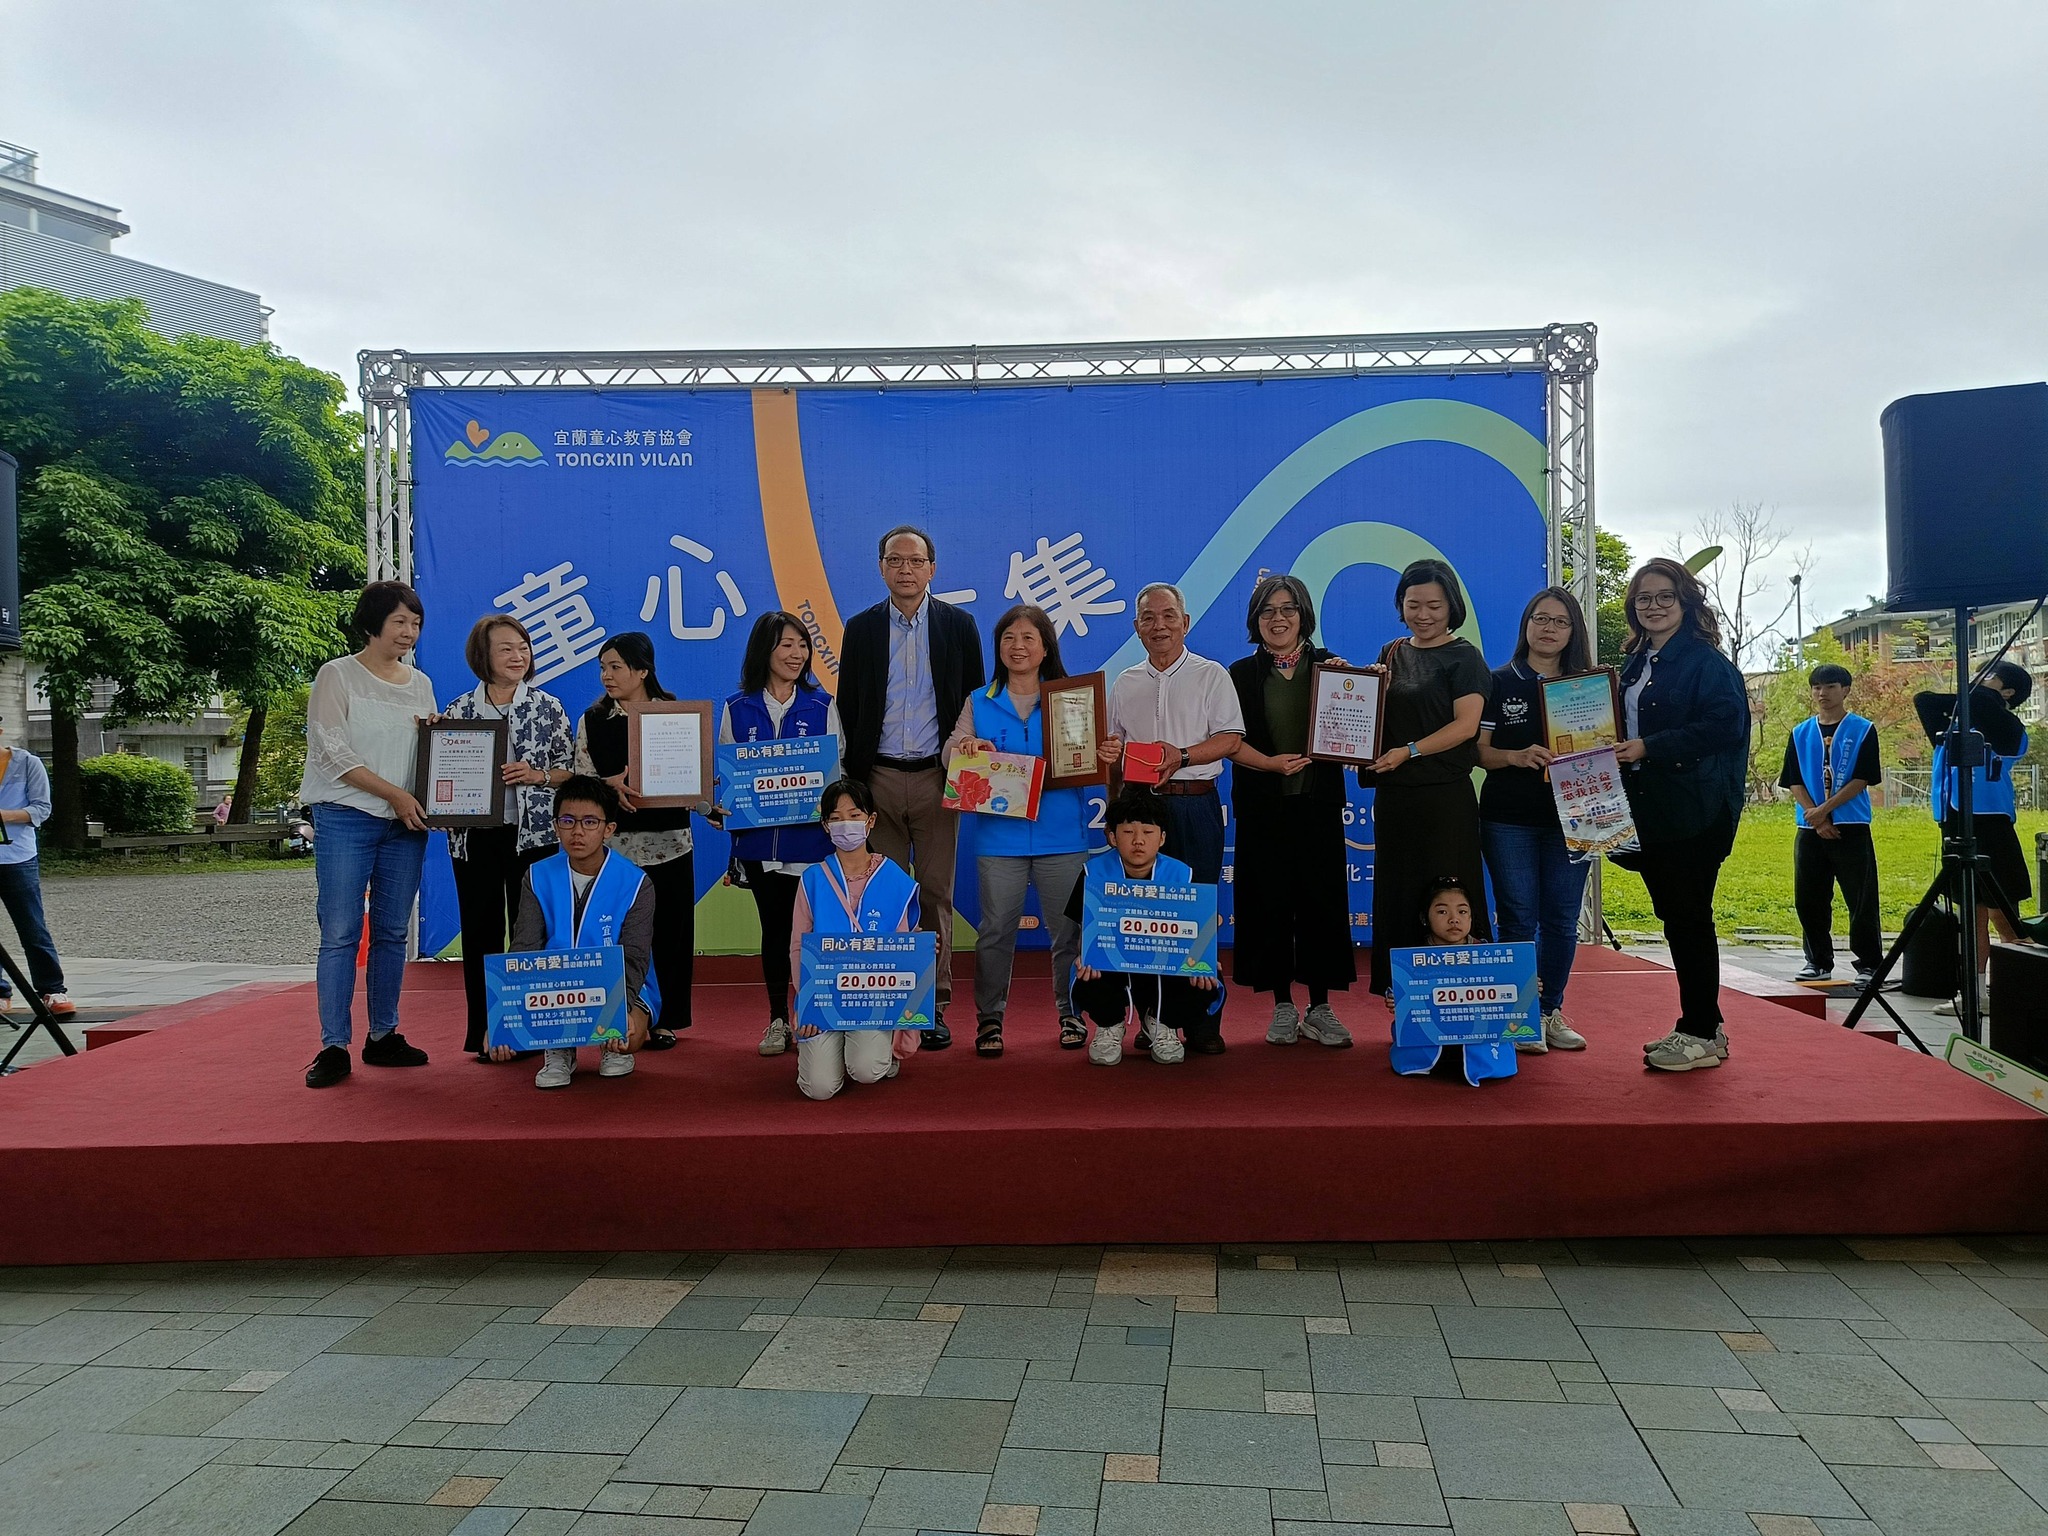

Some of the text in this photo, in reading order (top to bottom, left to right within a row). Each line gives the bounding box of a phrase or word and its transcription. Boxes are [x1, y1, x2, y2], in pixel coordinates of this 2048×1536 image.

[553, 428, 693, 446] 宜蘭童心教育協會
[736, 743, 785, 759] 同心有愛
[757, 775, 806, 790] 20,000
[1104, 882, 1157, 898] 同心有愛
[1123, 920, 1178, 935] 20,000
[821, 937, 875, 951] 同心有愛
[505, 955, 561, 972] 同心有愛
[1412, 950, 1470, 966] 同心有愛
[840, 975, 896, 988] 20,000
[528, 991, 586, 1008] 20,000
[1437, 988, 1496, 1003] 20,000
